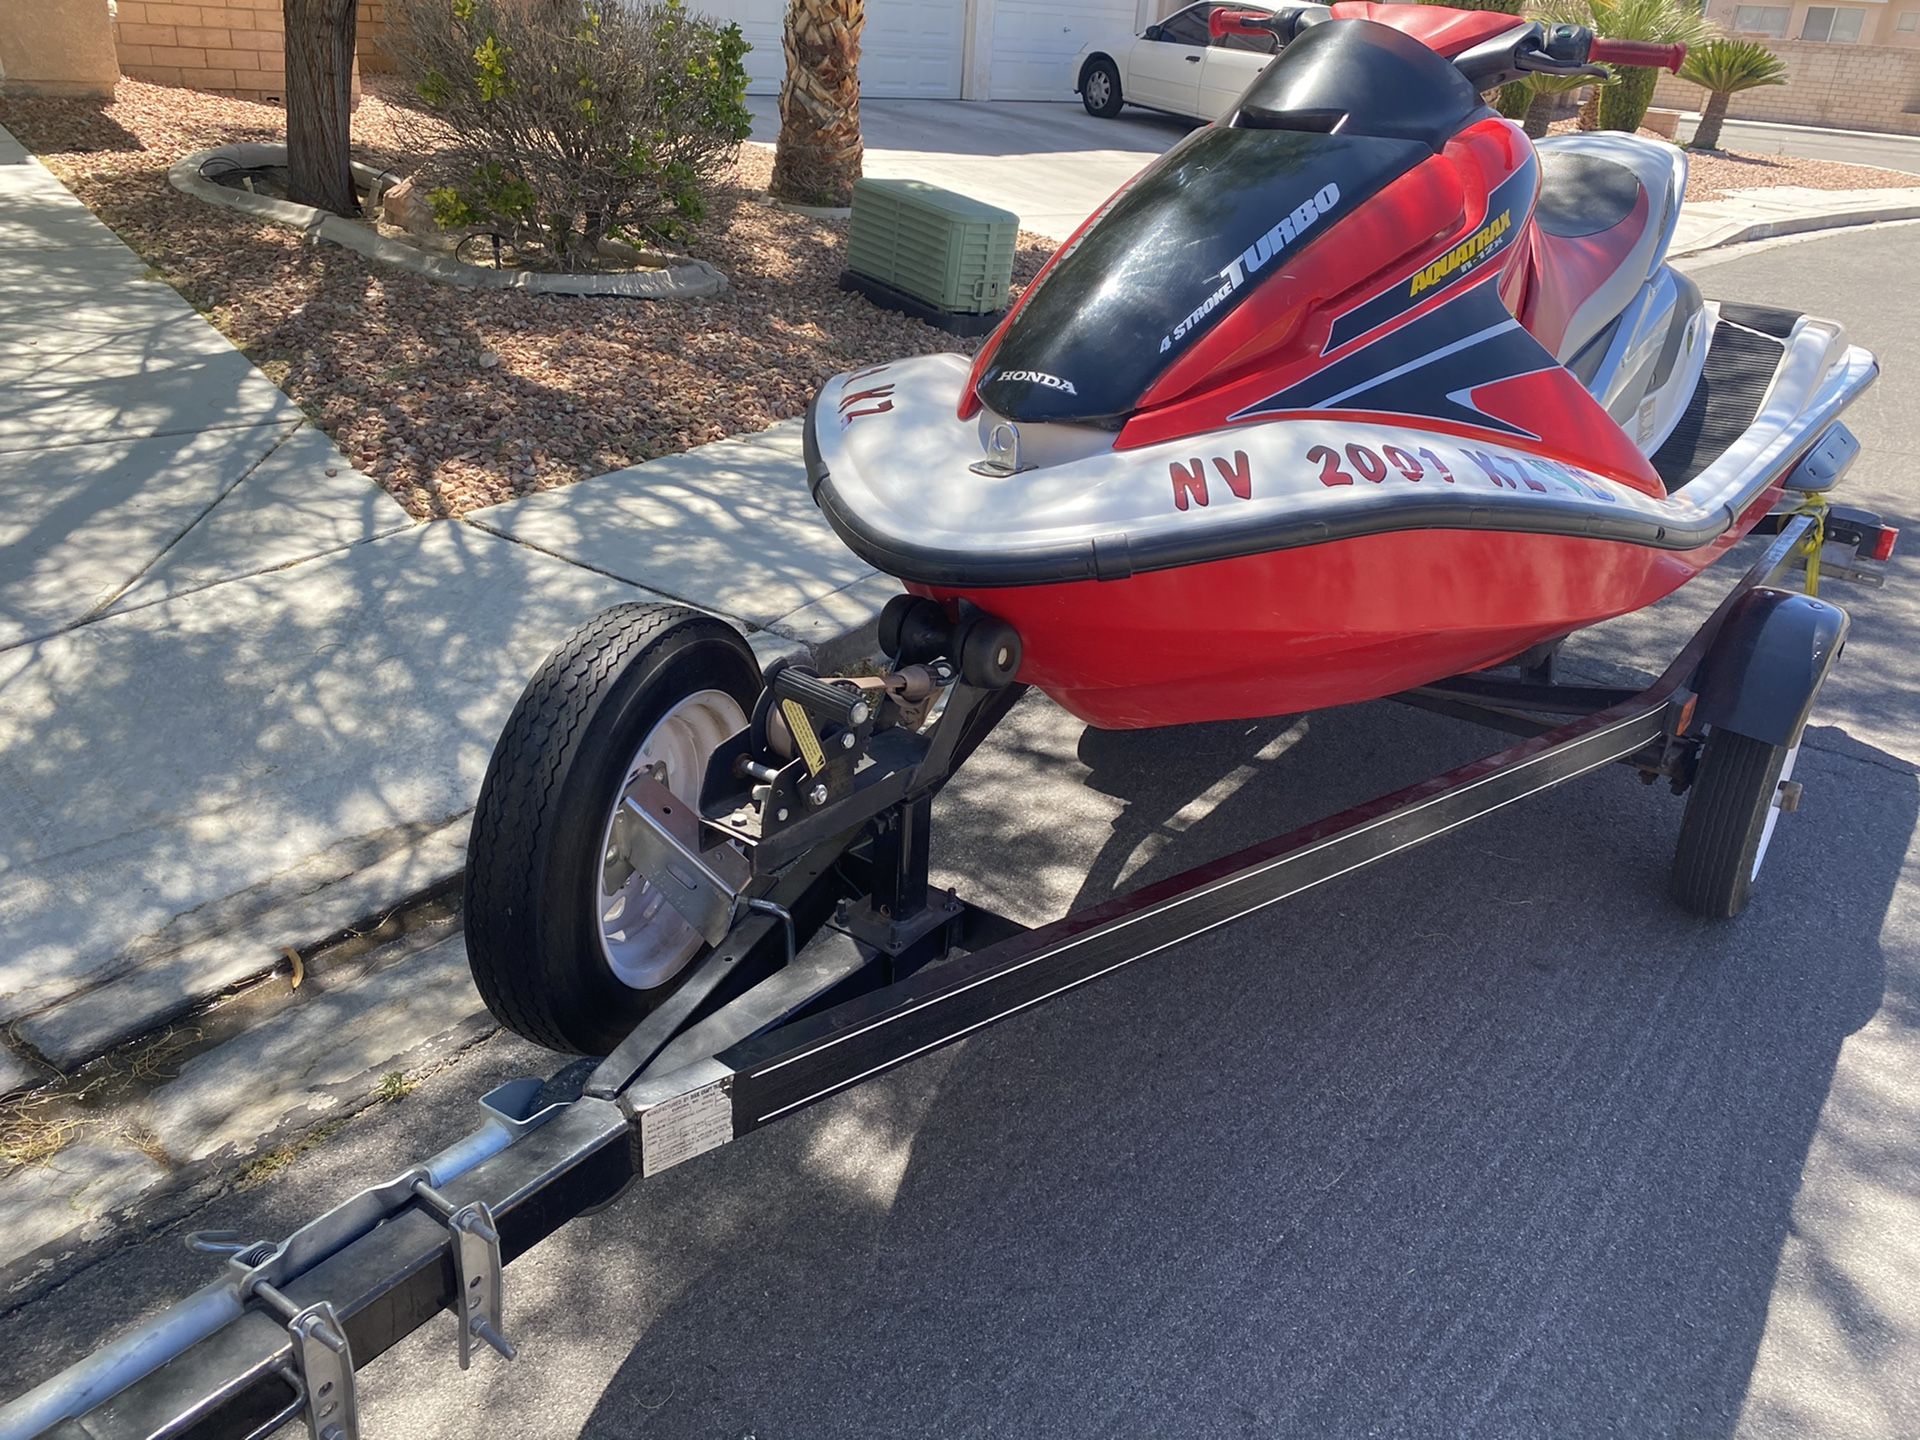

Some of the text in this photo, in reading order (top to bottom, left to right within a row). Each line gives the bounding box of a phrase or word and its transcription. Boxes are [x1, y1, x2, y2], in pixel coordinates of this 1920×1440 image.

[1160, 182, 1340, 353] 4 STROKE TURBO
[1409, 208, 1511, 297] AQUATRAX
[997, 370, 1078, 396] HONDA
[1169, 450, 1252, 511] NV
[1306, 443, 1455, 490] 2001
